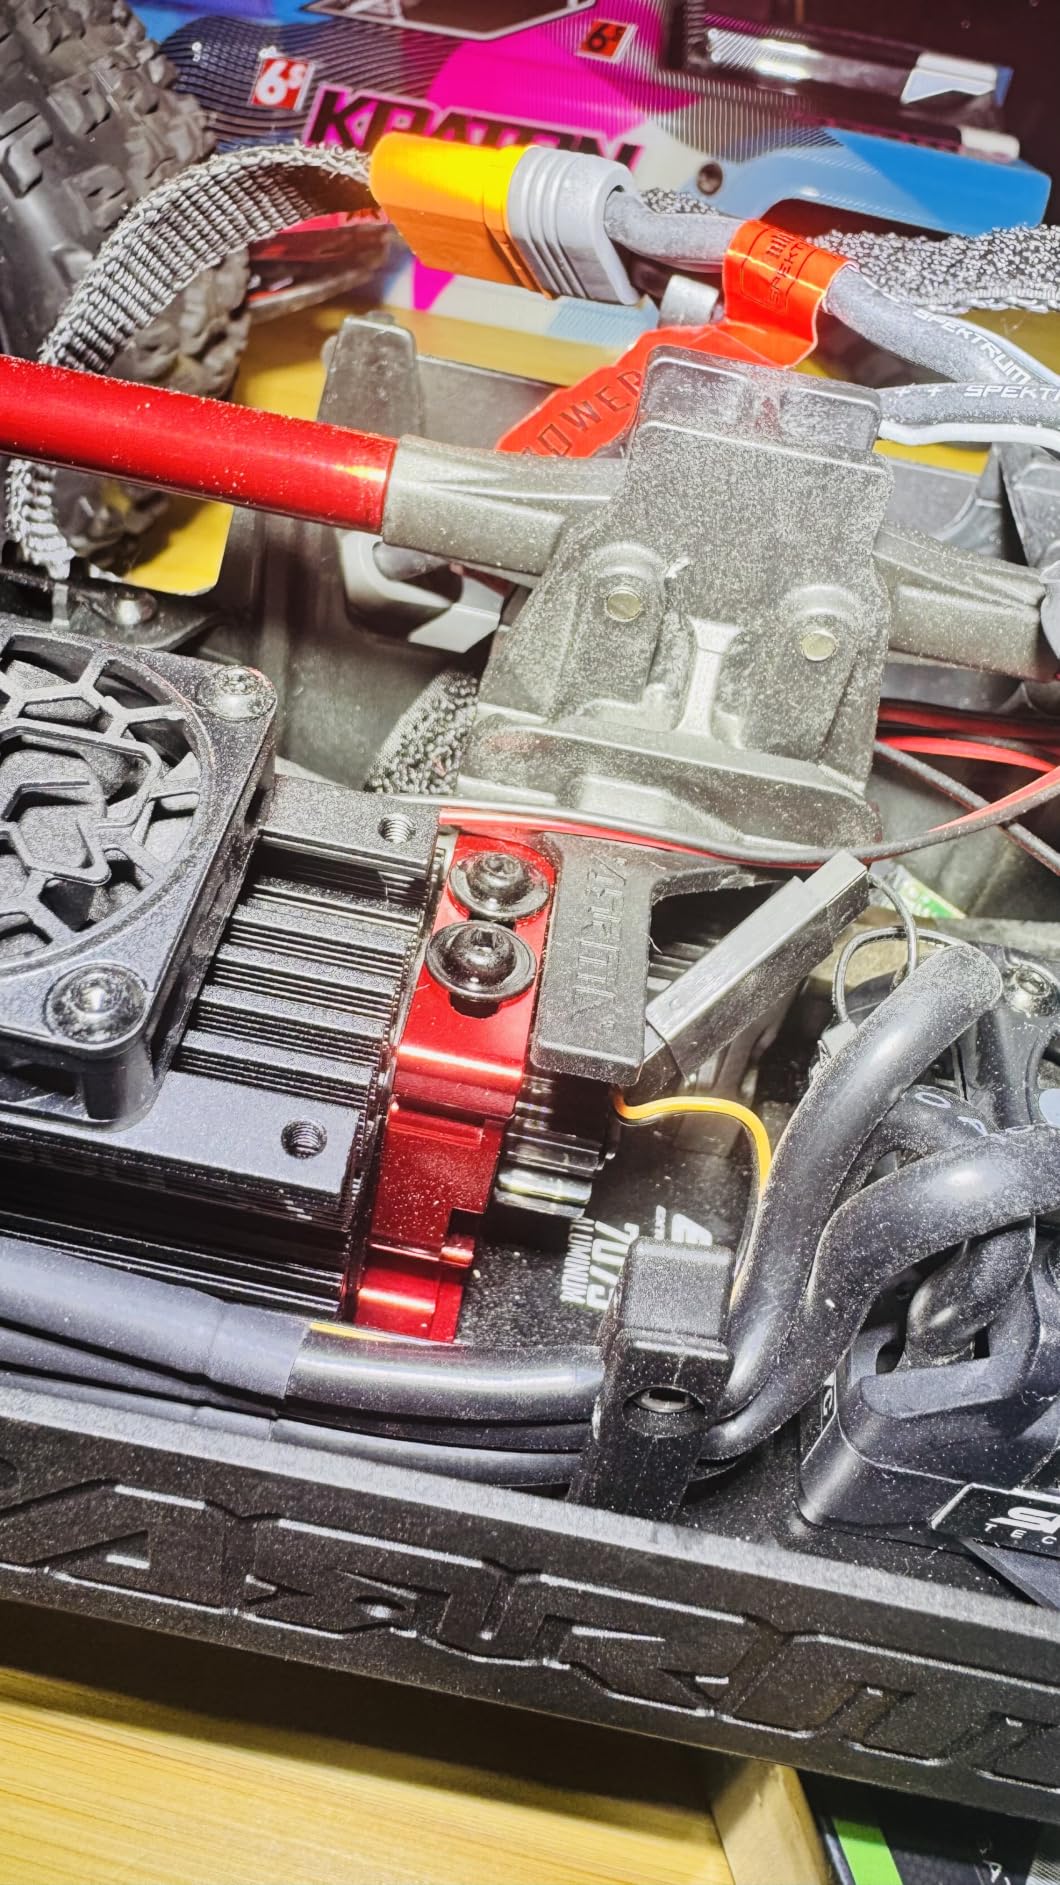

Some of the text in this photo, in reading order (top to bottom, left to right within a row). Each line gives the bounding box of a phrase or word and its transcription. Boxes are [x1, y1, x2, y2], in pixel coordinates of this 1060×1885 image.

[770, 241, 810, 303] SPEKT
[913, 308, 1032, 385] SPEKTRUM
[521, 370, 641, 457] OWER
